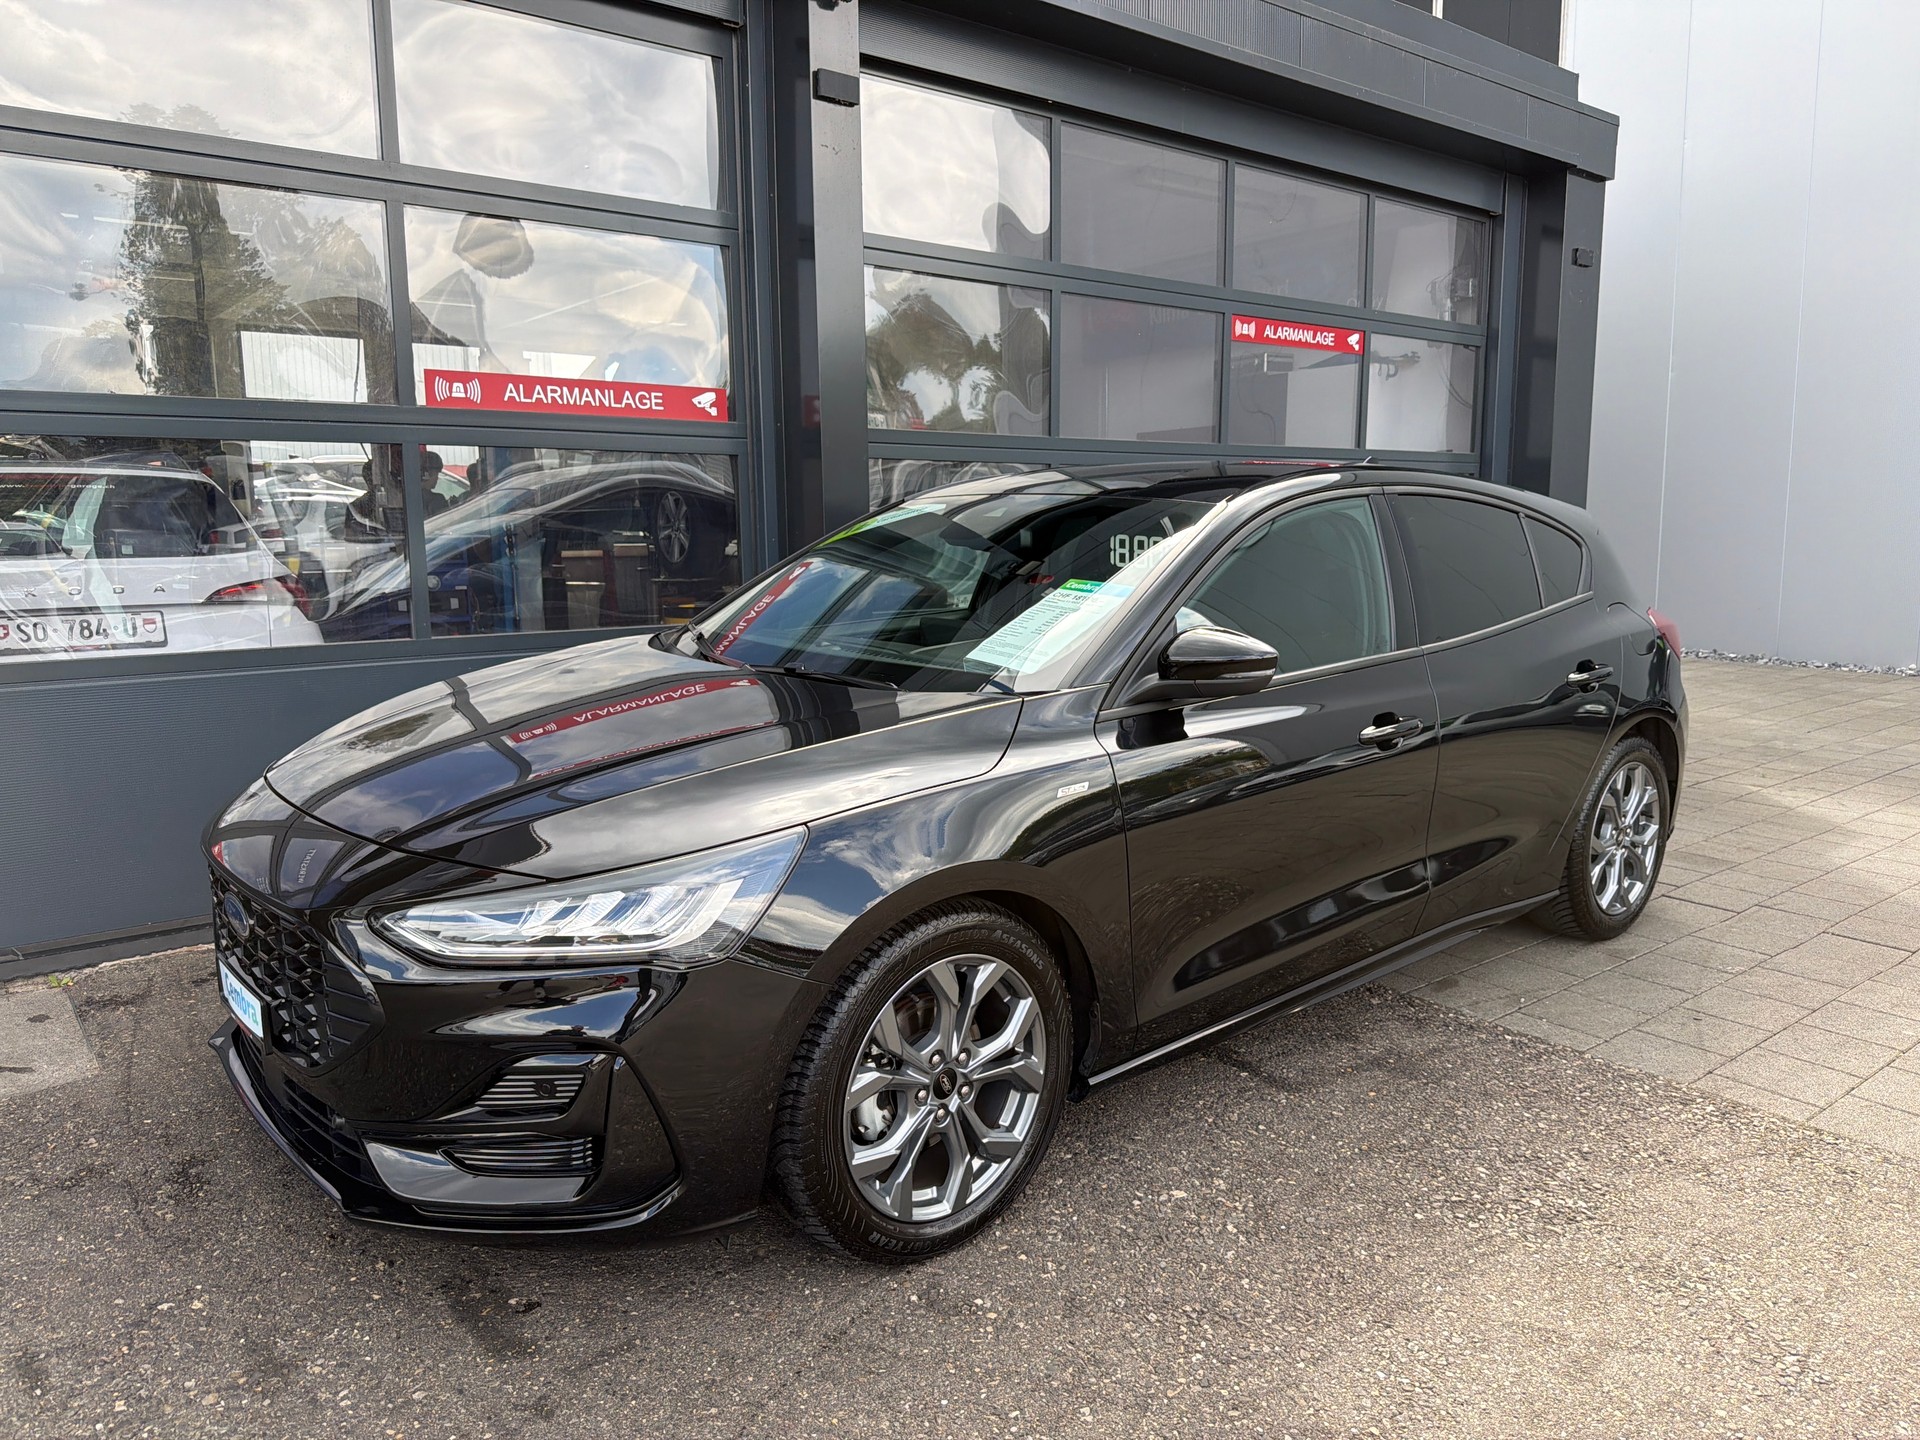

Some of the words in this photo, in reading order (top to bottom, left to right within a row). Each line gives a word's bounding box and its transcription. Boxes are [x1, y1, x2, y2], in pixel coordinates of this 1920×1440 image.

[1263, 325, 1336, 346] ALARMANLAGE
[503, 383, 665, 410] ALARMANLAGE
[16, 620, 49, 643] SO
[61, 618, 109, 641] 784
[122, 617, 138, 638] U
[225, 972, 259, 1027] Cembra
